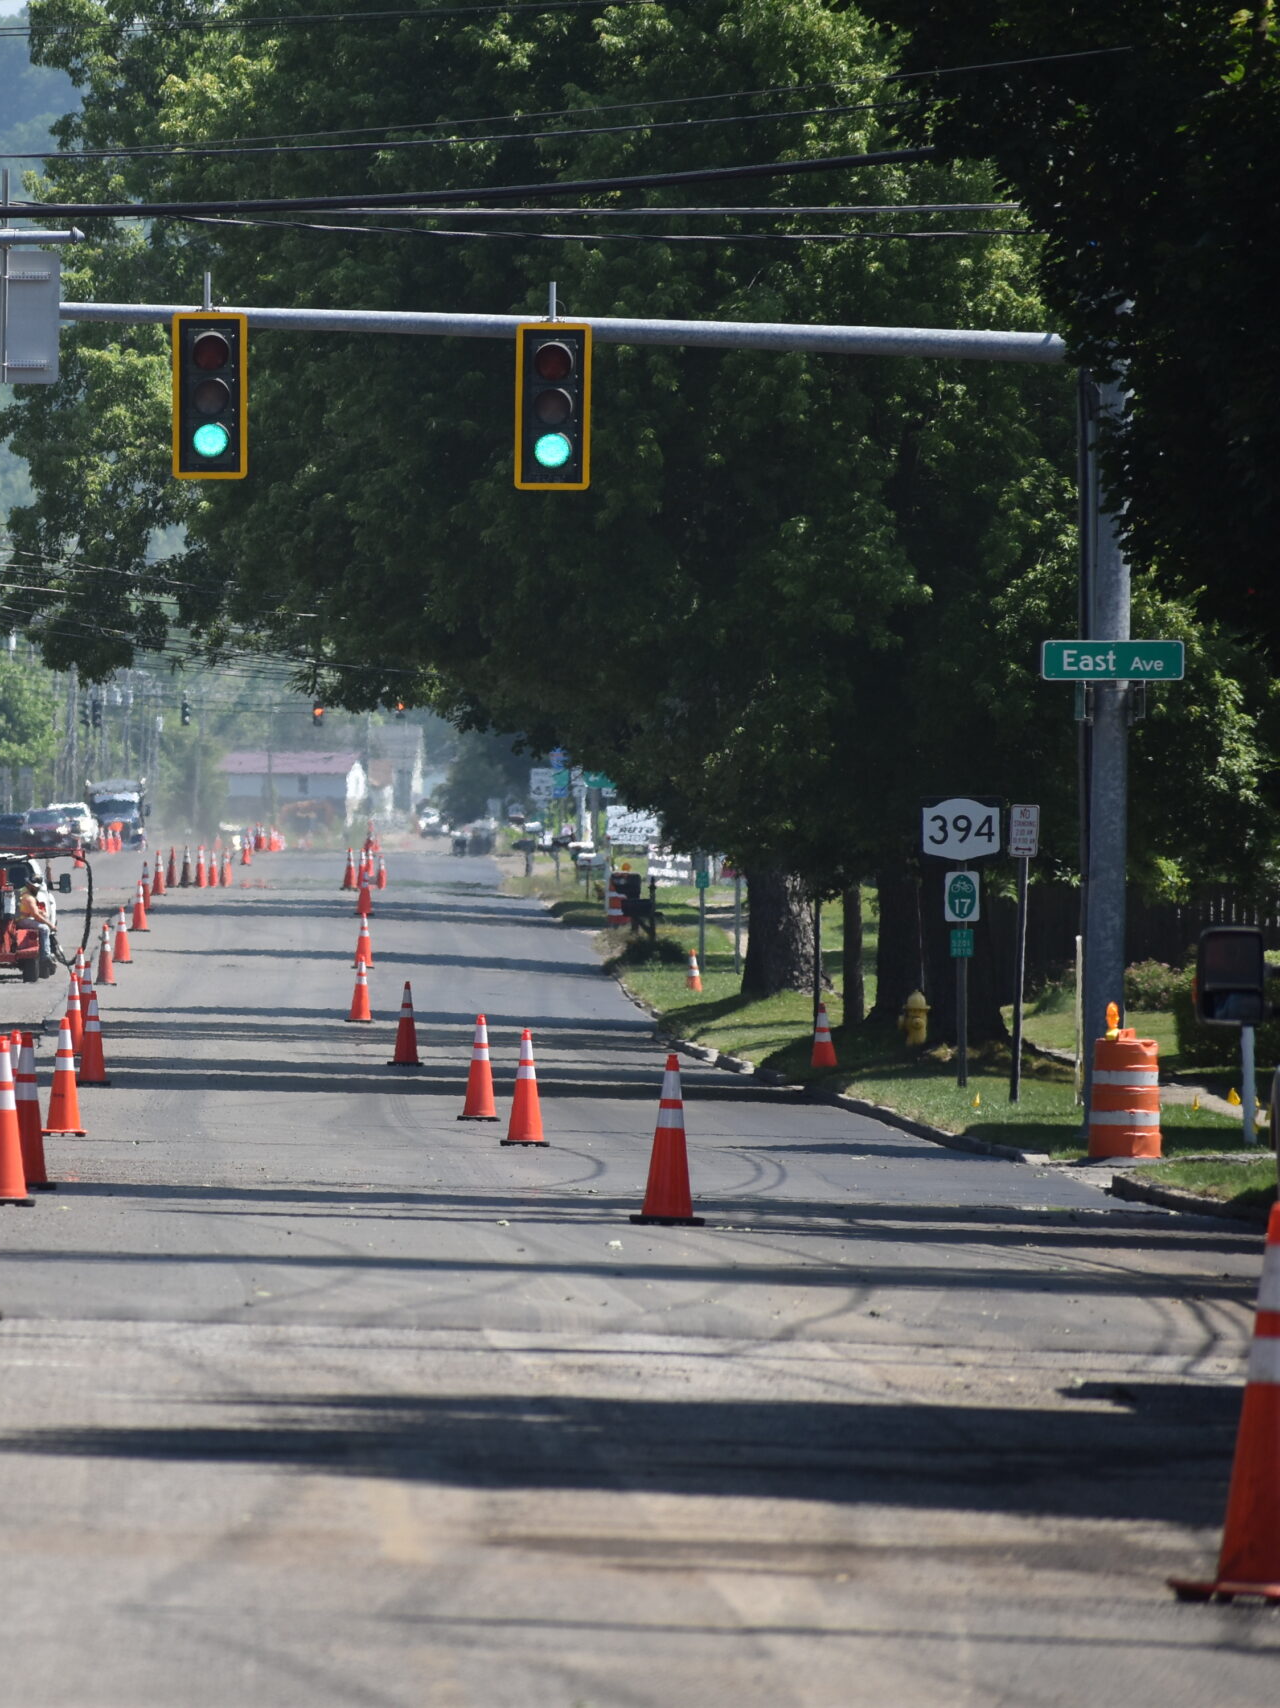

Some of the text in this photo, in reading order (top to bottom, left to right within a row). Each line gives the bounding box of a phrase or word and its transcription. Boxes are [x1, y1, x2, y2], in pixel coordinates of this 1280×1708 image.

[1062, 650, 1165, 671] East Ave
[1019, 809, 1031, 819] NO
[928, 815, 995, 844] 394
[954, 898, 971, 914] 17
